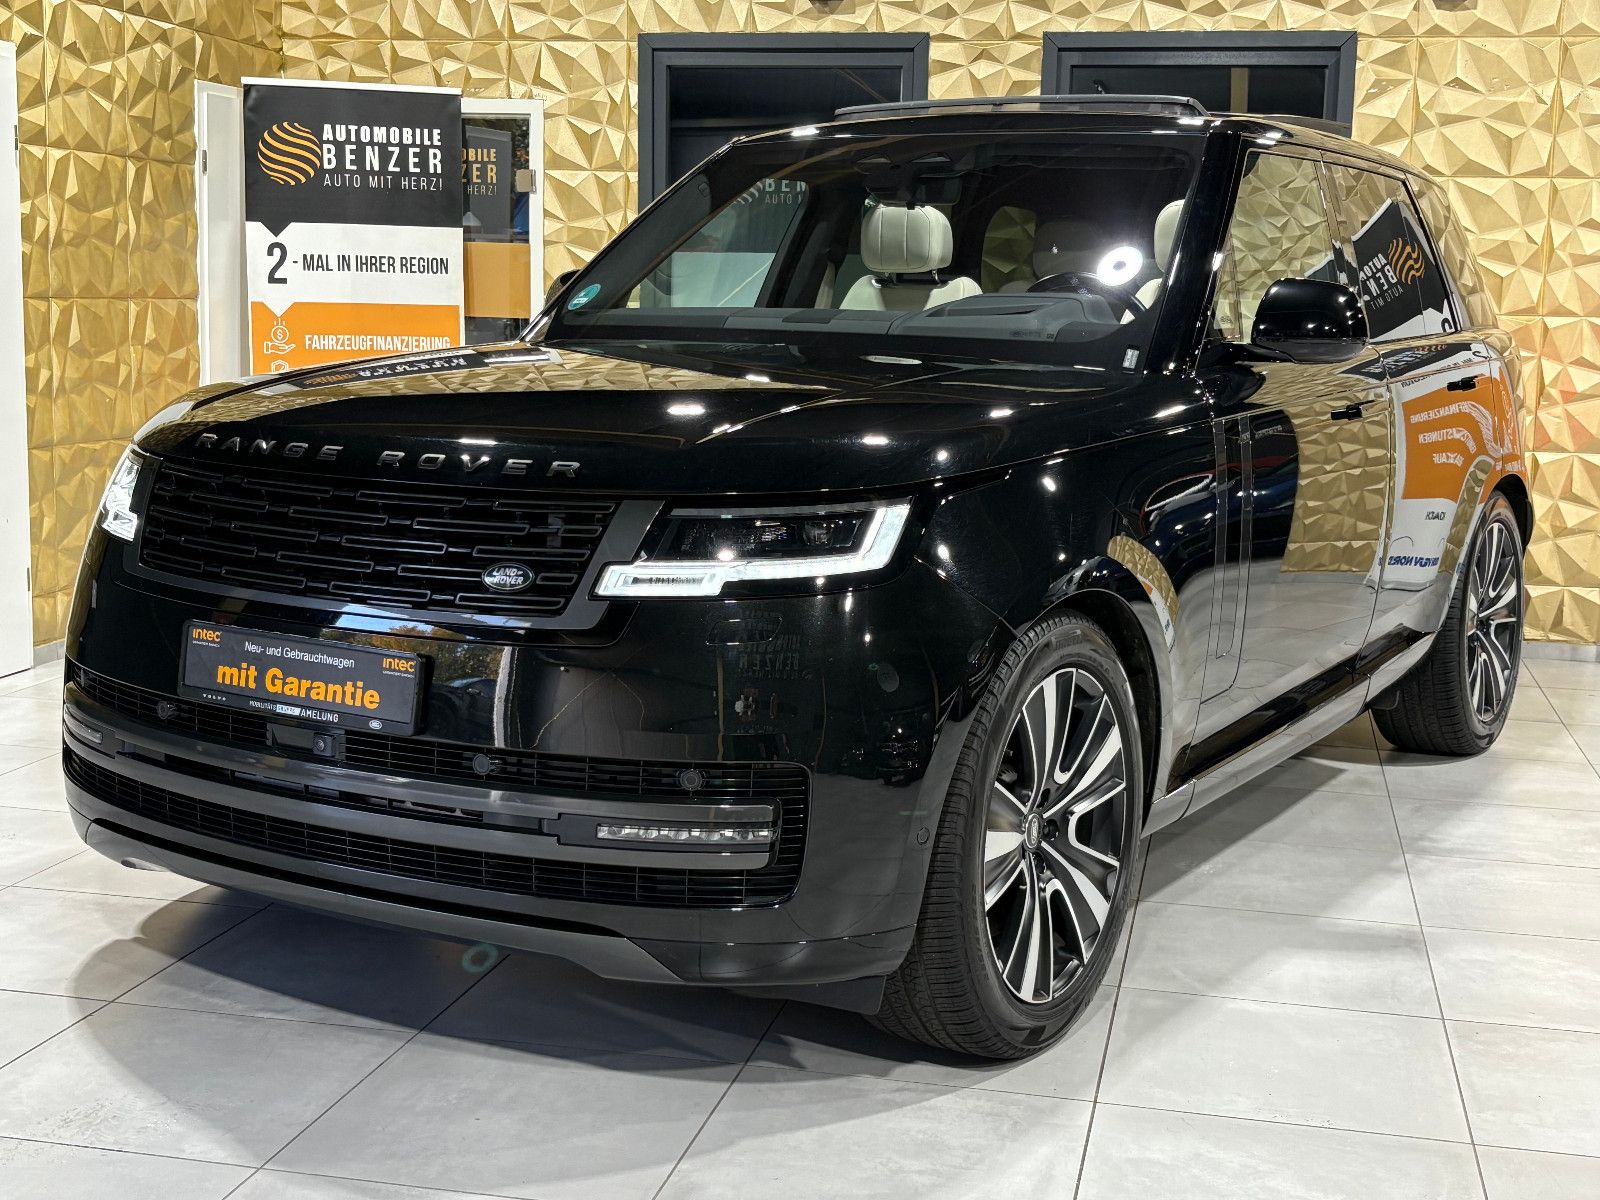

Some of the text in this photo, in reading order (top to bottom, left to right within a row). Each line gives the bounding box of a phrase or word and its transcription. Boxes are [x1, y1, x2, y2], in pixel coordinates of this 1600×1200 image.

[322, 123, 441, 146] AUTOMOBILE
[322, 143, 442, 174] BENZER
[323, 173, 443, 191] AUTO MIT HERZ!
[764, 193, 792, 205] AUTO
[266, 241, 288, 285] 2
[302, 253, 334, 272] MAL
[337, 254, 351, 272] IN
[355, 254, 396, 273] IHRER
[400, 256, 449, 275] REGION
[304, 334, 451, 352] FAHRZEUGFINANZIERUNG
[195, 432, 582, 478] RANGE ROVER
[192, 628, 222, 642] intec
[244, 641, 355, 669] Neu- und Gebrauchtwagen
[382, 657, 417, 673] intec
[216, 662, 381, 710] mit Garantie
[300, 708, 339, 723] AMELUNG
